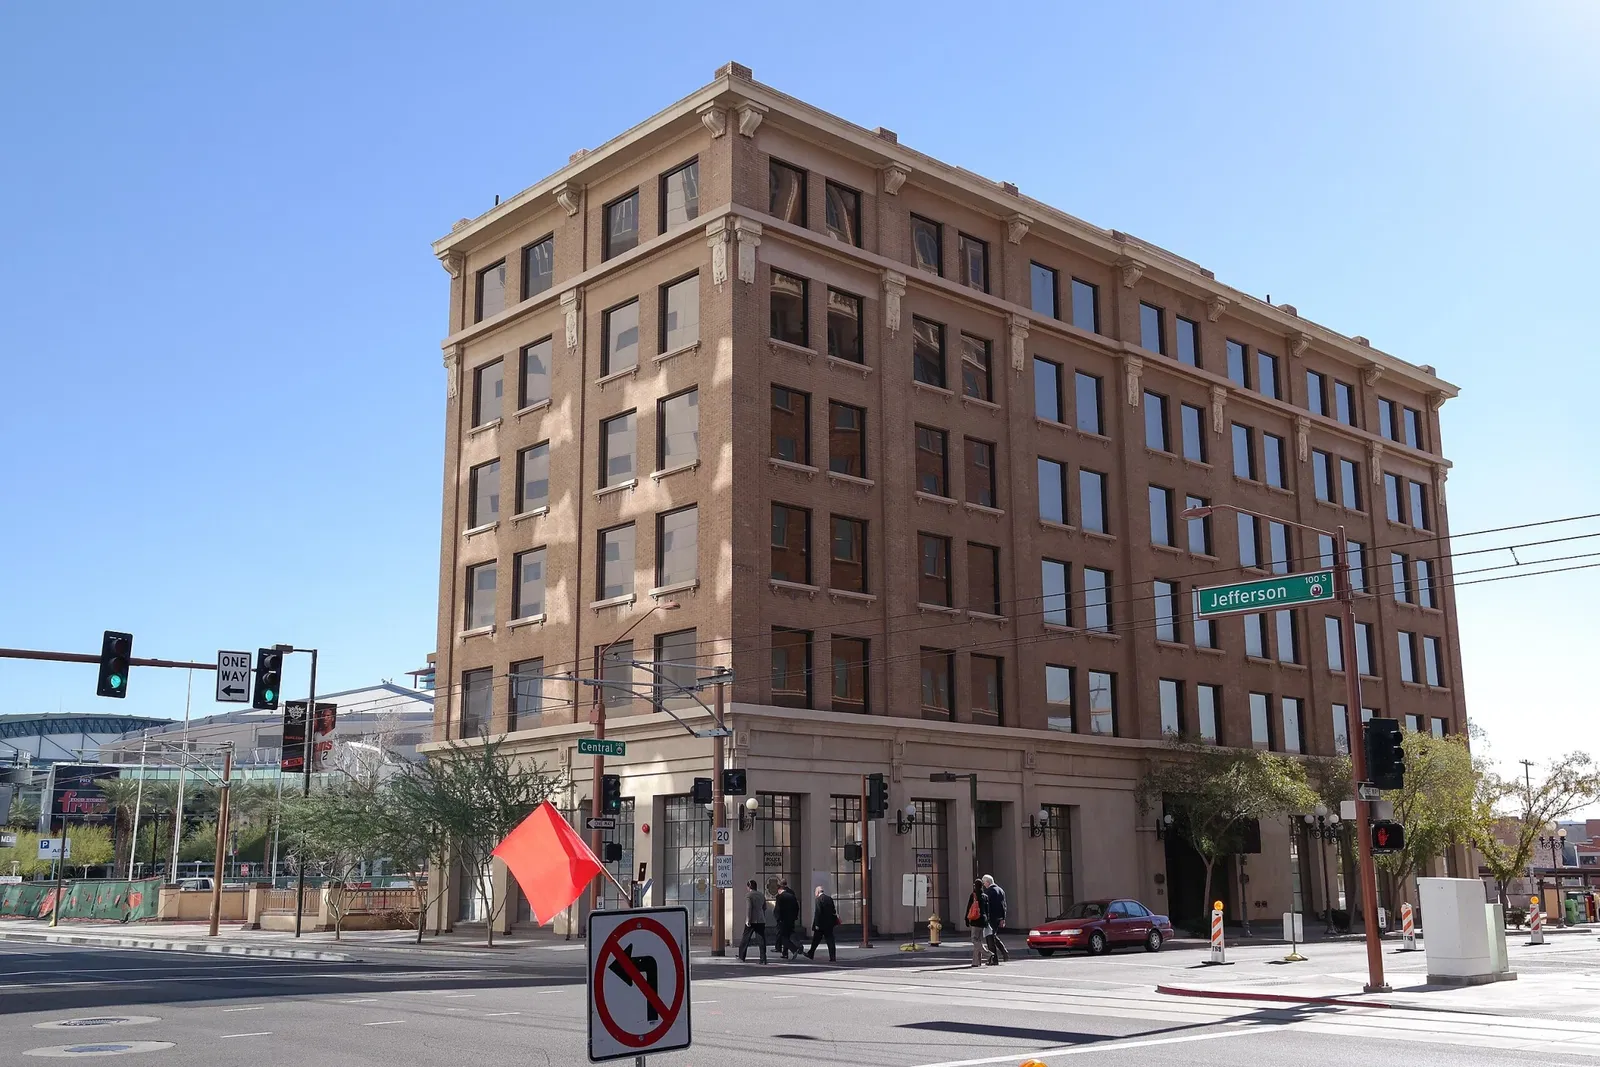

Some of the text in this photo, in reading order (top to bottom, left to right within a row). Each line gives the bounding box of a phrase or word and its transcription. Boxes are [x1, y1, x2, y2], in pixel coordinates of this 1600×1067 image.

[1304, 574, 1327, 584] 100 S
[1210, 586, 1287, 608] Jefferson
[222, 656, 247, 668] ONE
[221, 670, 247, 682] WAY
[580, 741, 613, 753] Central
[717, 830, 730, 842] 20
